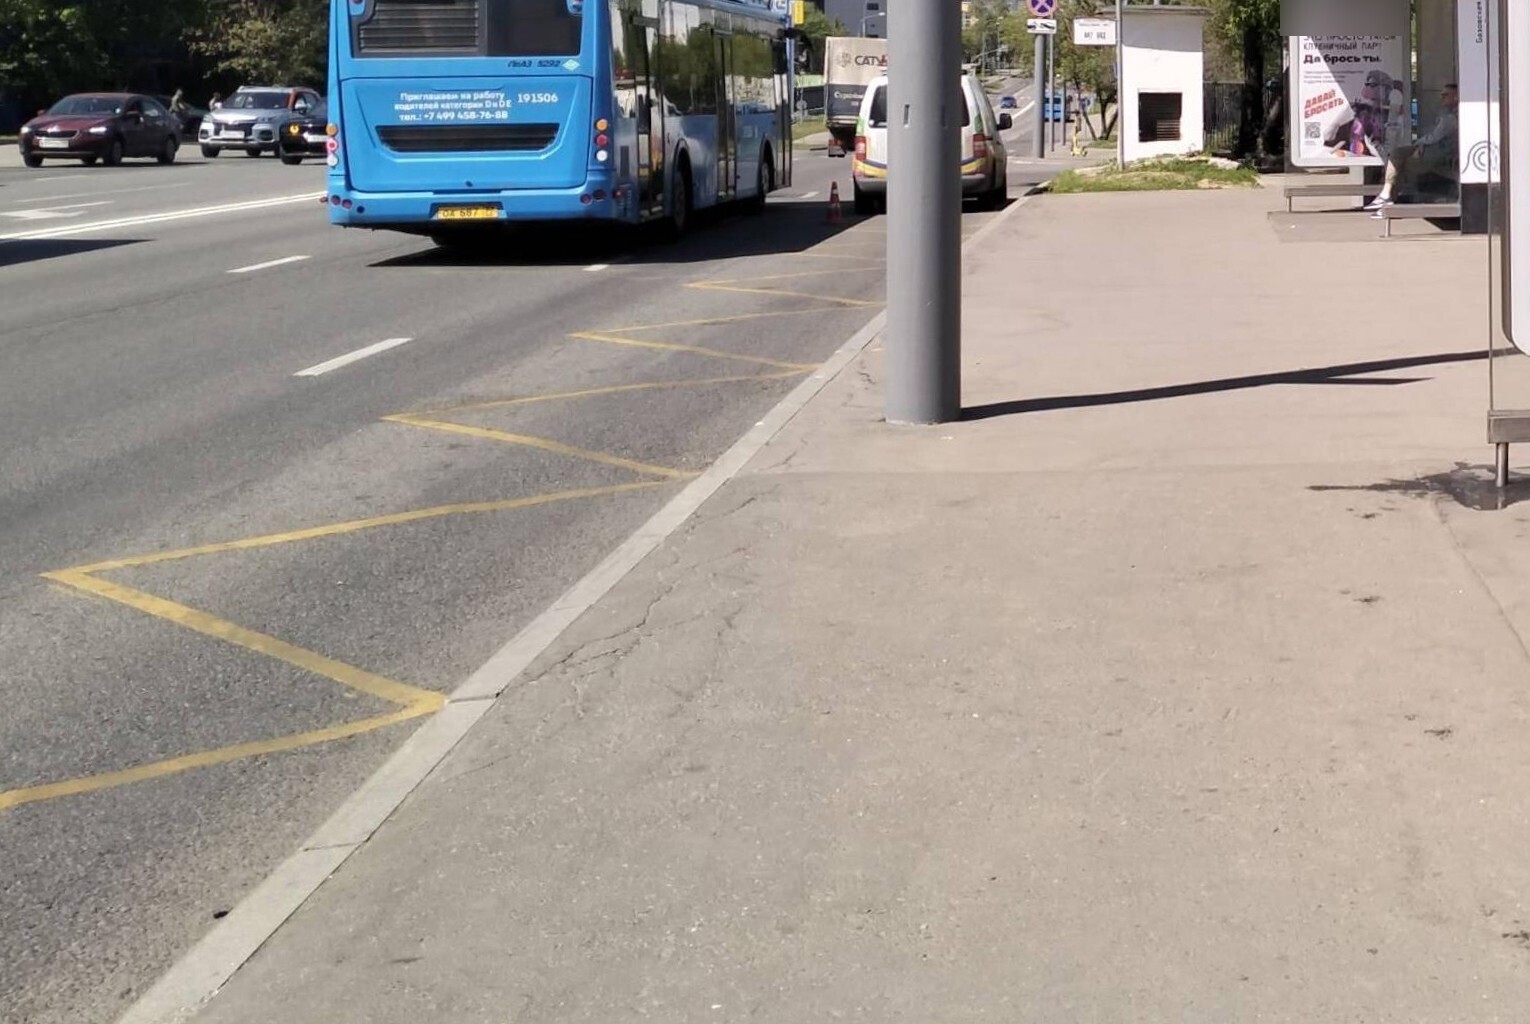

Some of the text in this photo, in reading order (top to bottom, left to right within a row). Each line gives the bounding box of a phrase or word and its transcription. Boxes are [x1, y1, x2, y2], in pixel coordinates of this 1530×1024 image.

[1303, 55, 1321, 64] Да
[1323, 53, 1361, 65] брось
[473, 90, 505, 101] работу
[517, 93, 559, 103] 191506
